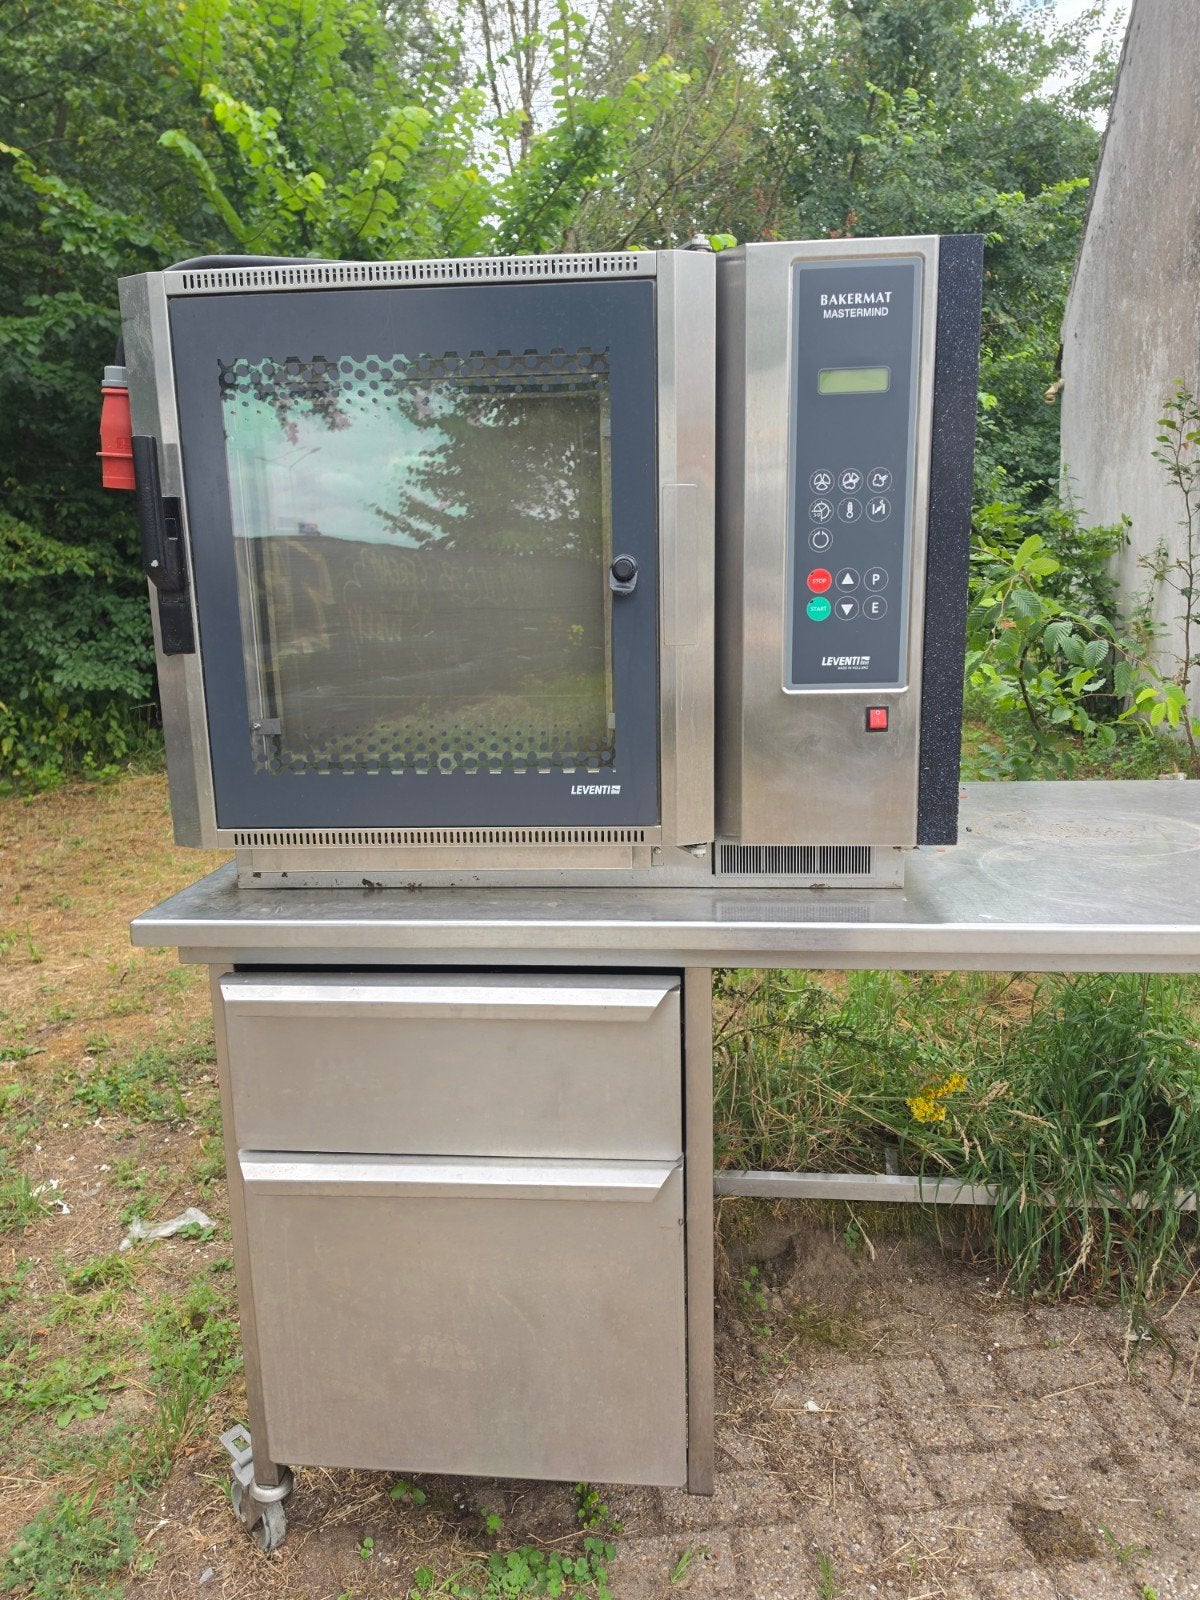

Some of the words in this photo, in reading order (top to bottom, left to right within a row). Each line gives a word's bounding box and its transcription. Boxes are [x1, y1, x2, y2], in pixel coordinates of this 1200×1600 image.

[820, 292, 892, 306] BAKERMAT
[823, 306, 889, 319] MASTERMIND
[872, 573, 880, 585] P
[871, 602, 879, 613] E
[821, 656, 861, 666] LEVENTI
[571, 785, 611, 795] LEVENTI
